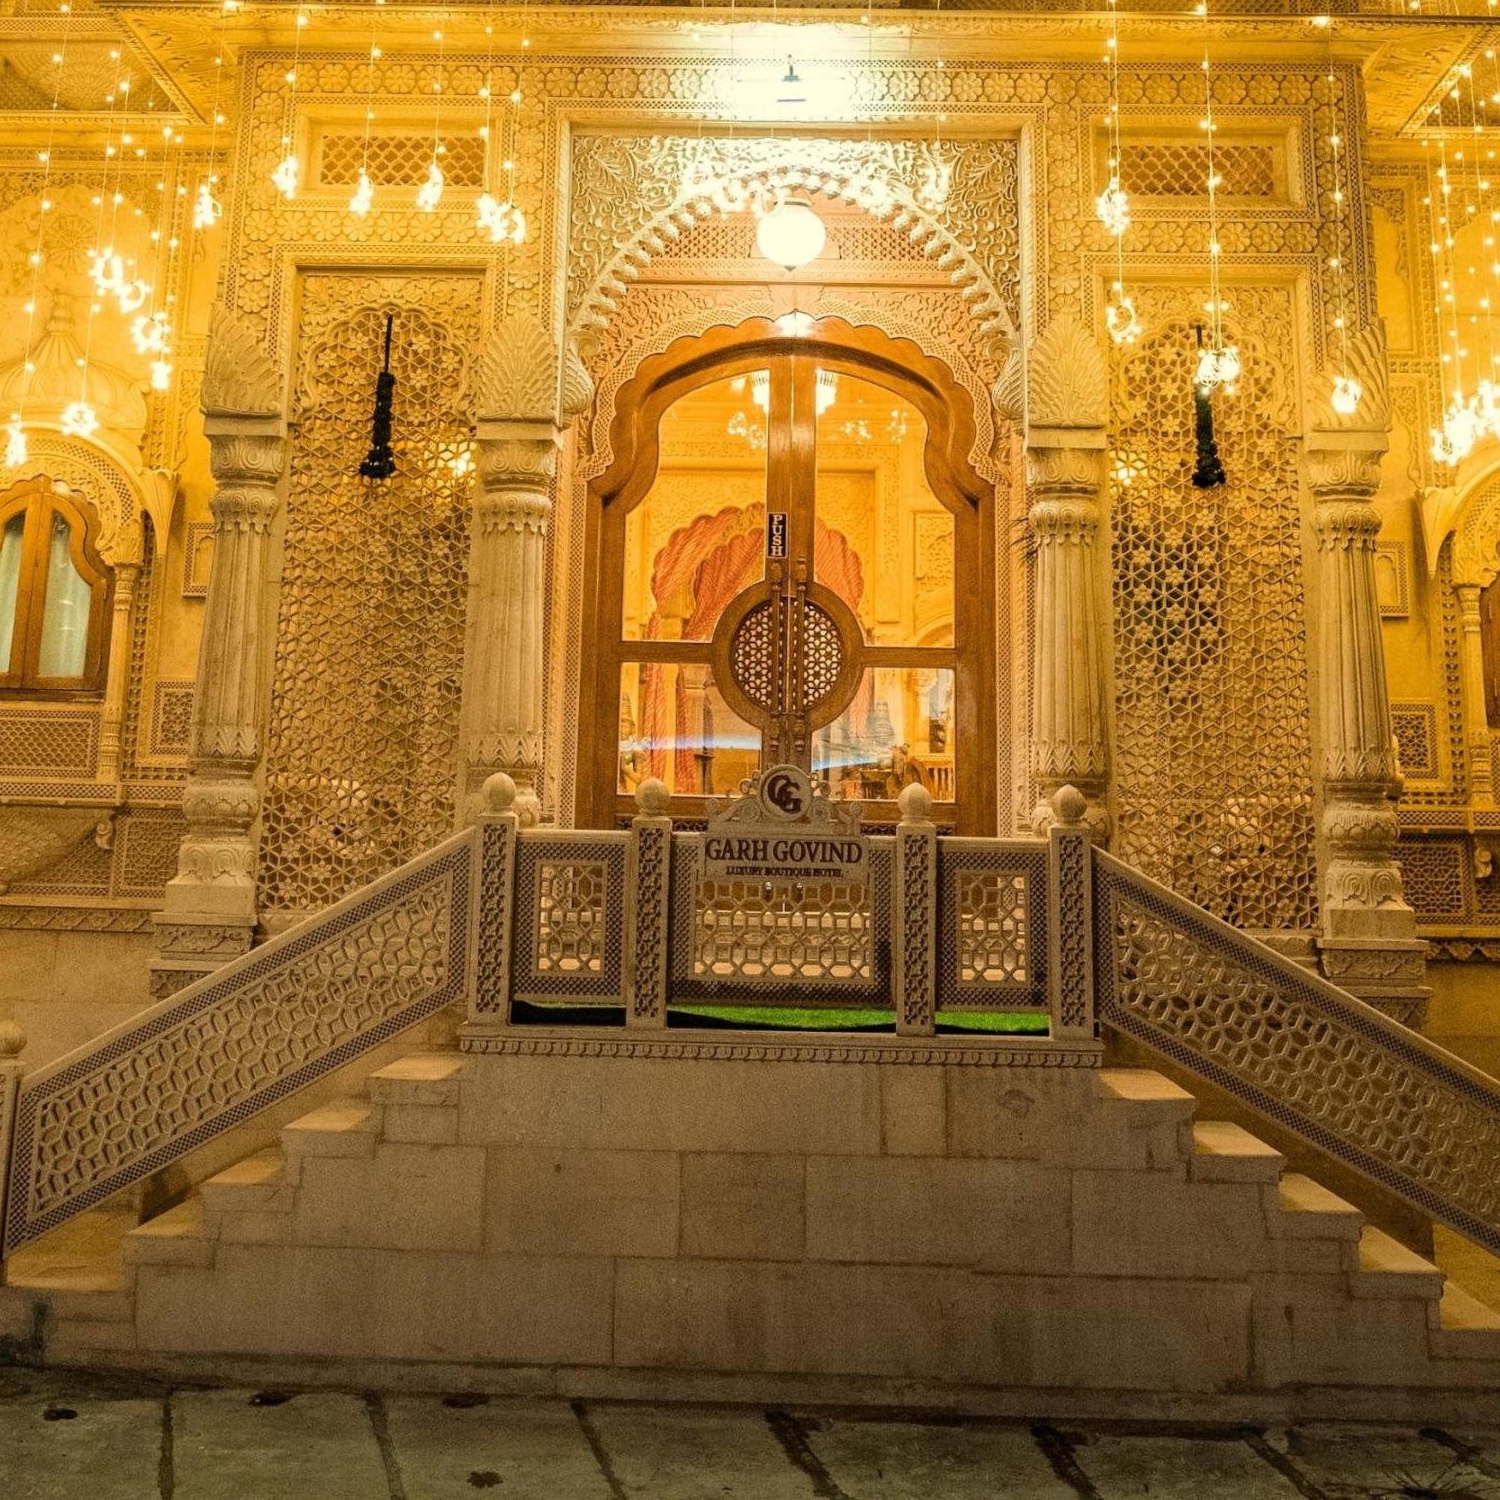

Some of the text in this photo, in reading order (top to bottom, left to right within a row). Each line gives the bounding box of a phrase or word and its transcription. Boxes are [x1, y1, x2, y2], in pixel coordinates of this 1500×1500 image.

[771, 514, 783, 556] PUSH
[705, 838, 863, 864] GARH GOVIND
[725, 866, 762, 876] LUXURY
[764, 866, 813, 878] BOUTIQUE
